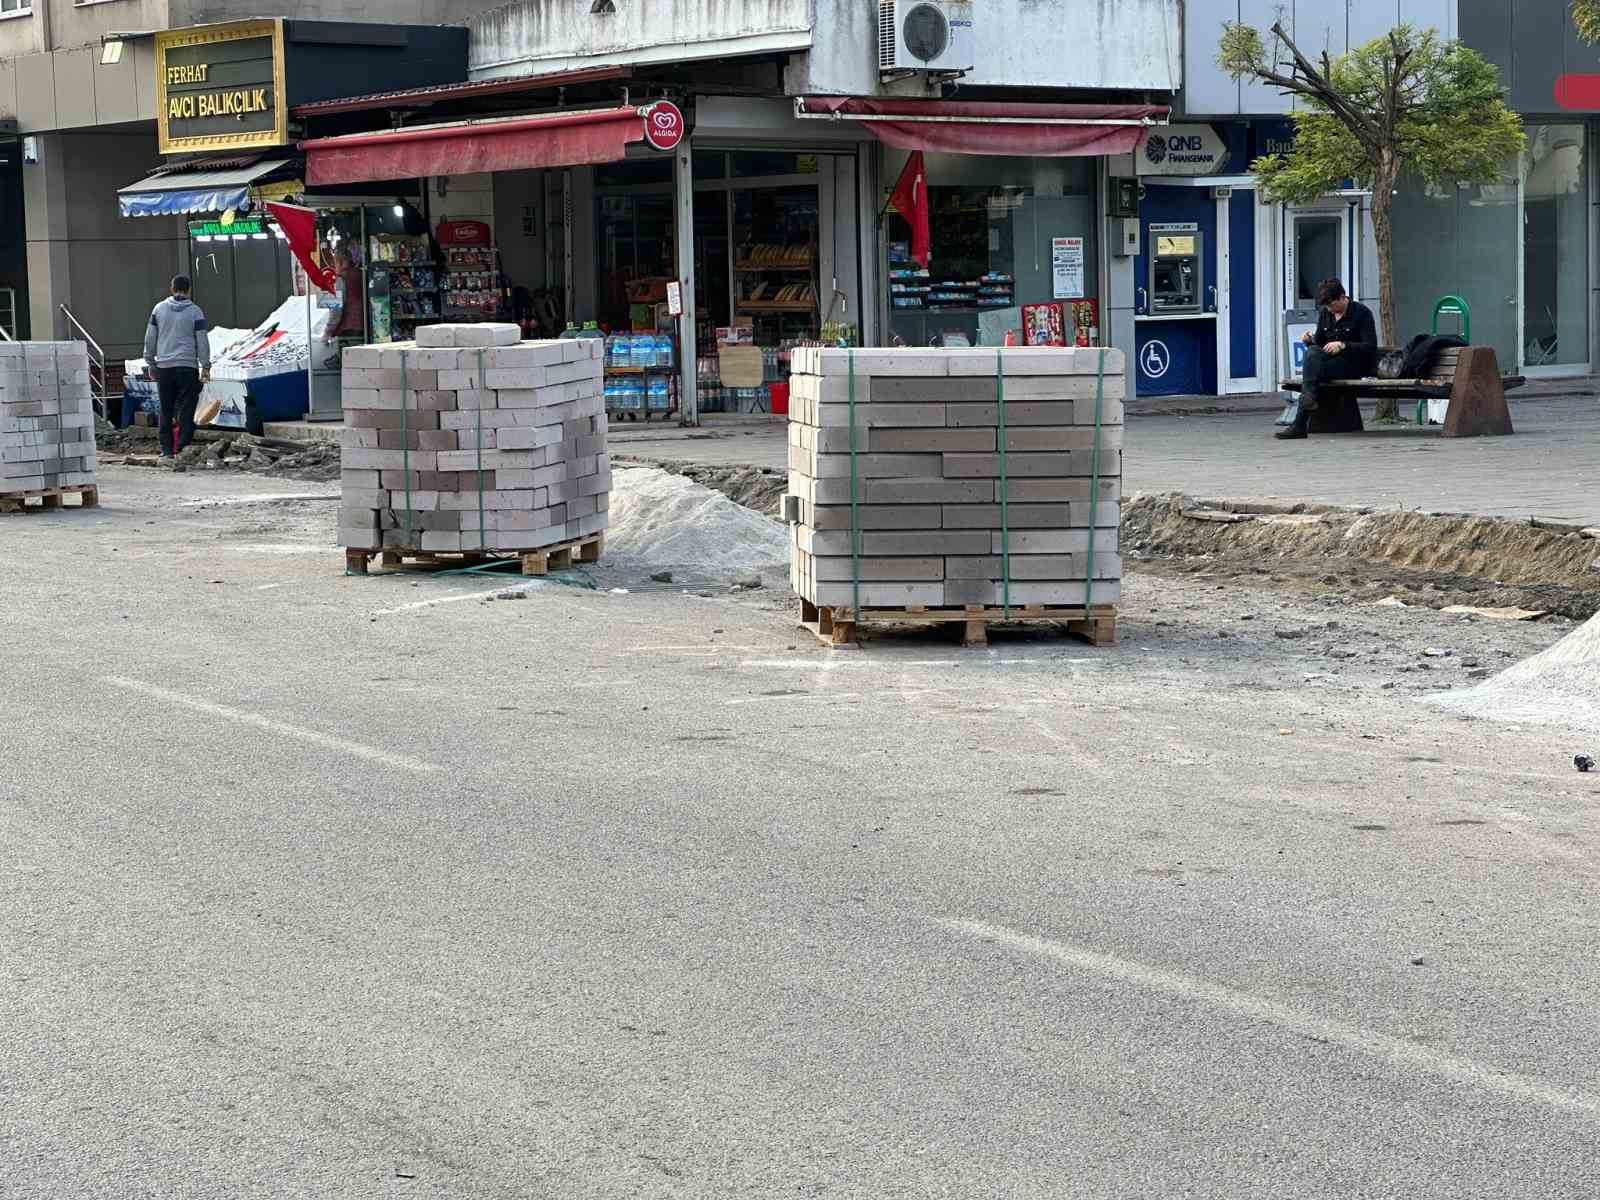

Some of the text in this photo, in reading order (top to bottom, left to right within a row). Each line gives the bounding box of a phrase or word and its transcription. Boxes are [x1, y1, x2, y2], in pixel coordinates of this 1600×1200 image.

[168, 64, 207, 84] FERHAT
[169, 89, 267, 120] AVCI BALIKÇILIK
[653, 129, 677, 137] ALGIDA
[1168, 136, 1202, 151] QNB
